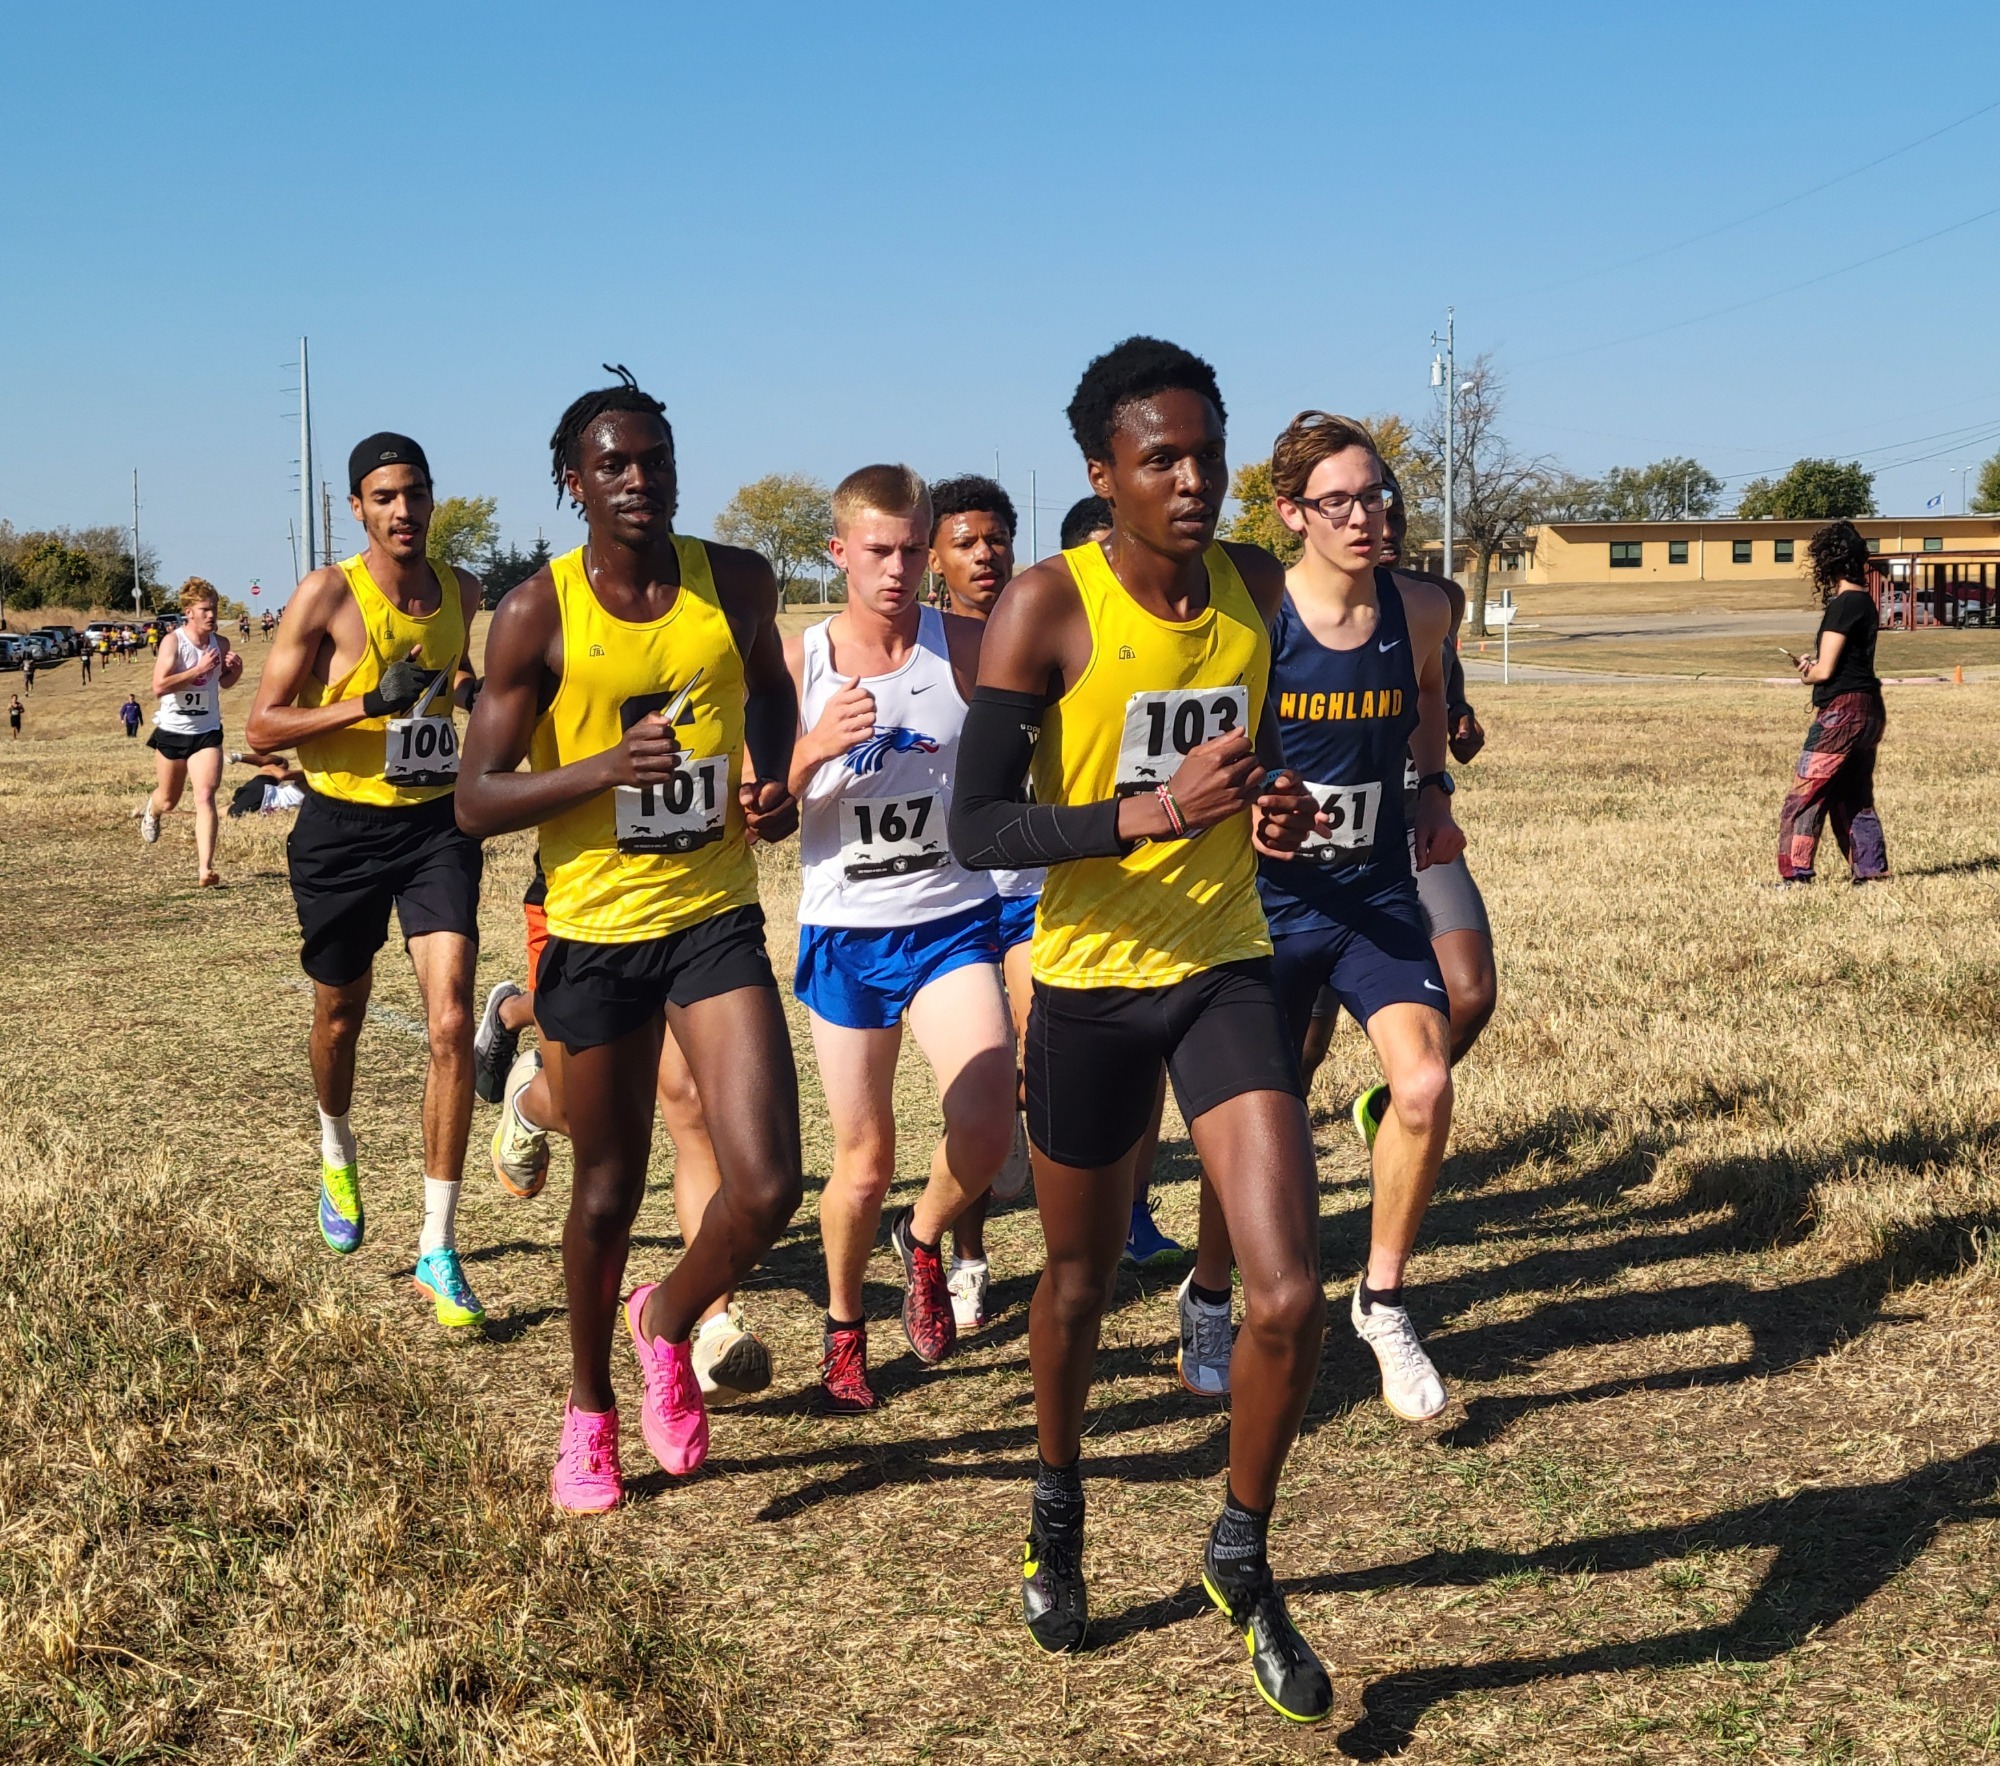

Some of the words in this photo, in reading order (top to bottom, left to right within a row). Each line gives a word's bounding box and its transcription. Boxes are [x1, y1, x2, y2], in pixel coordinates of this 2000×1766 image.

[184, 693, 201, 706] 91
[1280, 689, 1403, 721] HIGHLAND
[401, 722, 454, 760] 100
[1147, 696, 1239, 757] 103
[640, 765, 715, 817] 101
[1321, 791, 1367, 831] 61
[854, 796, 934, 845] 167
